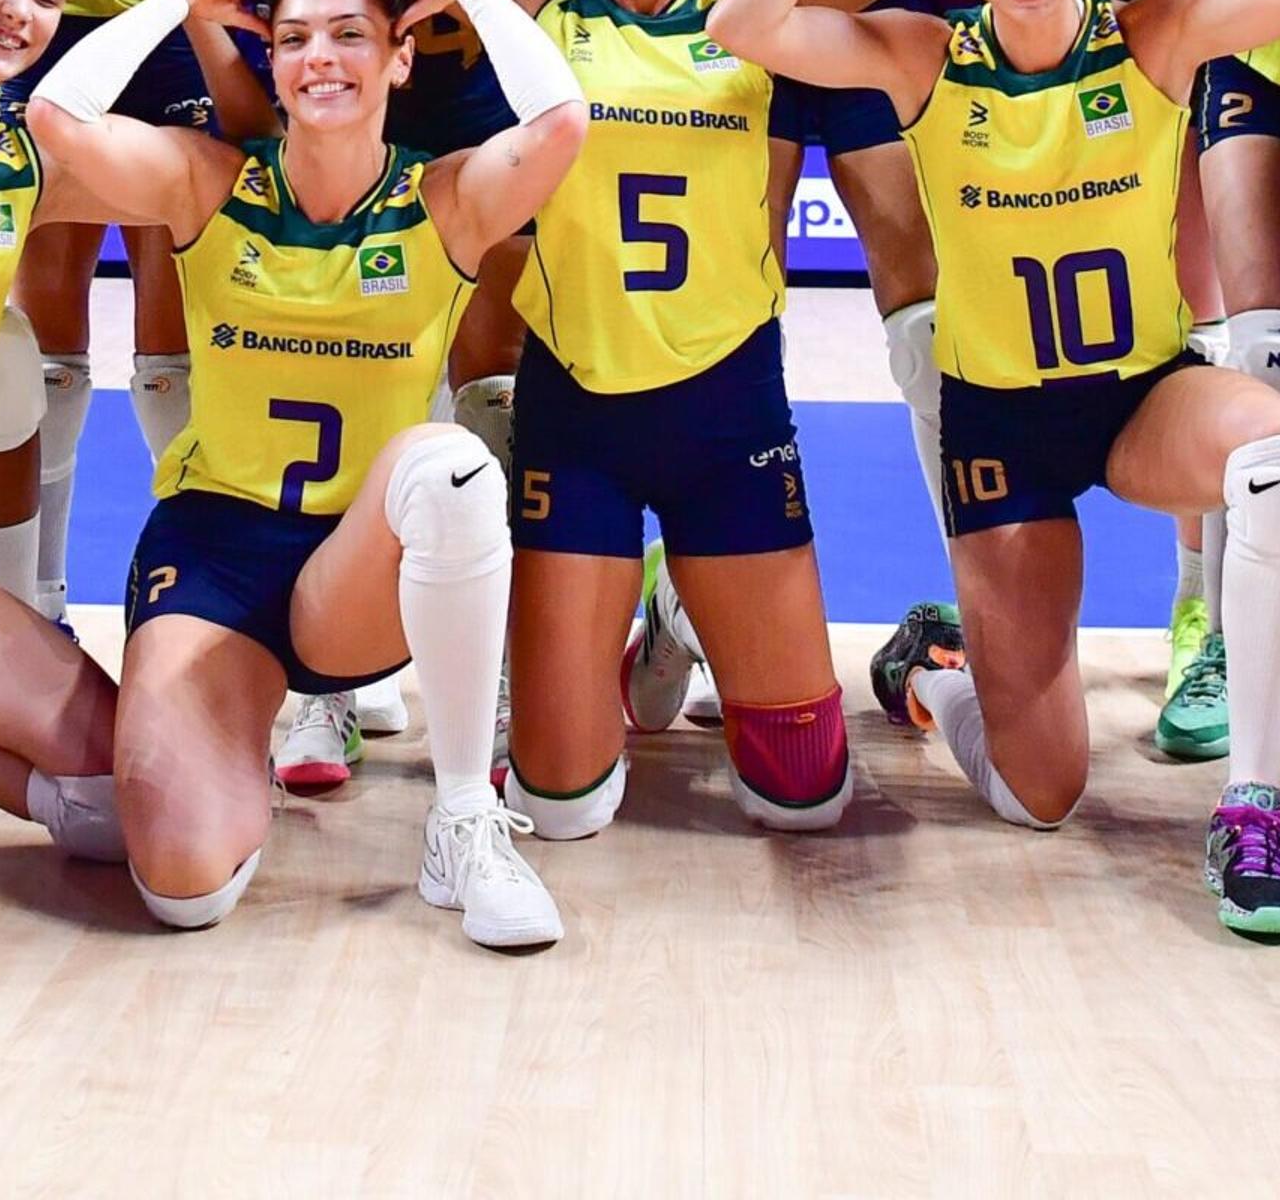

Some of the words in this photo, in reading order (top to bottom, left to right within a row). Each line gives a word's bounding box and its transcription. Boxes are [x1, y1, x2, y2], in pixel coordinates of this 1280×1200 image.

[694, 58, 740, 72] BRASIL
[589, 102, 658, 125] BANCO
[661, 111, 687, 126] DO
[690, 110, 750, 132] BRASIL
[1086, 116, 1132, 136] BRASIL
[1220, 92, 1253, 128] 2
[987, 188, 1052, 209] BANCO
[1055, 187, 1080, 206] DO
[1082, 173, 1142, 200] BRASIL
[617, 172, 690, 292] 5
[789, 199, 844, 238] p.
[361, 277, 409, 294] BRASIL
[1012, 248, 1135, 370] 10
[242, 330, 312, 355] BANCO
[315, 341, 343, 357] DO
[345, 339, 414, 359] BRASIL
[521, 470, 553, 520] 5
[952, 456, 1009, 504] 10
